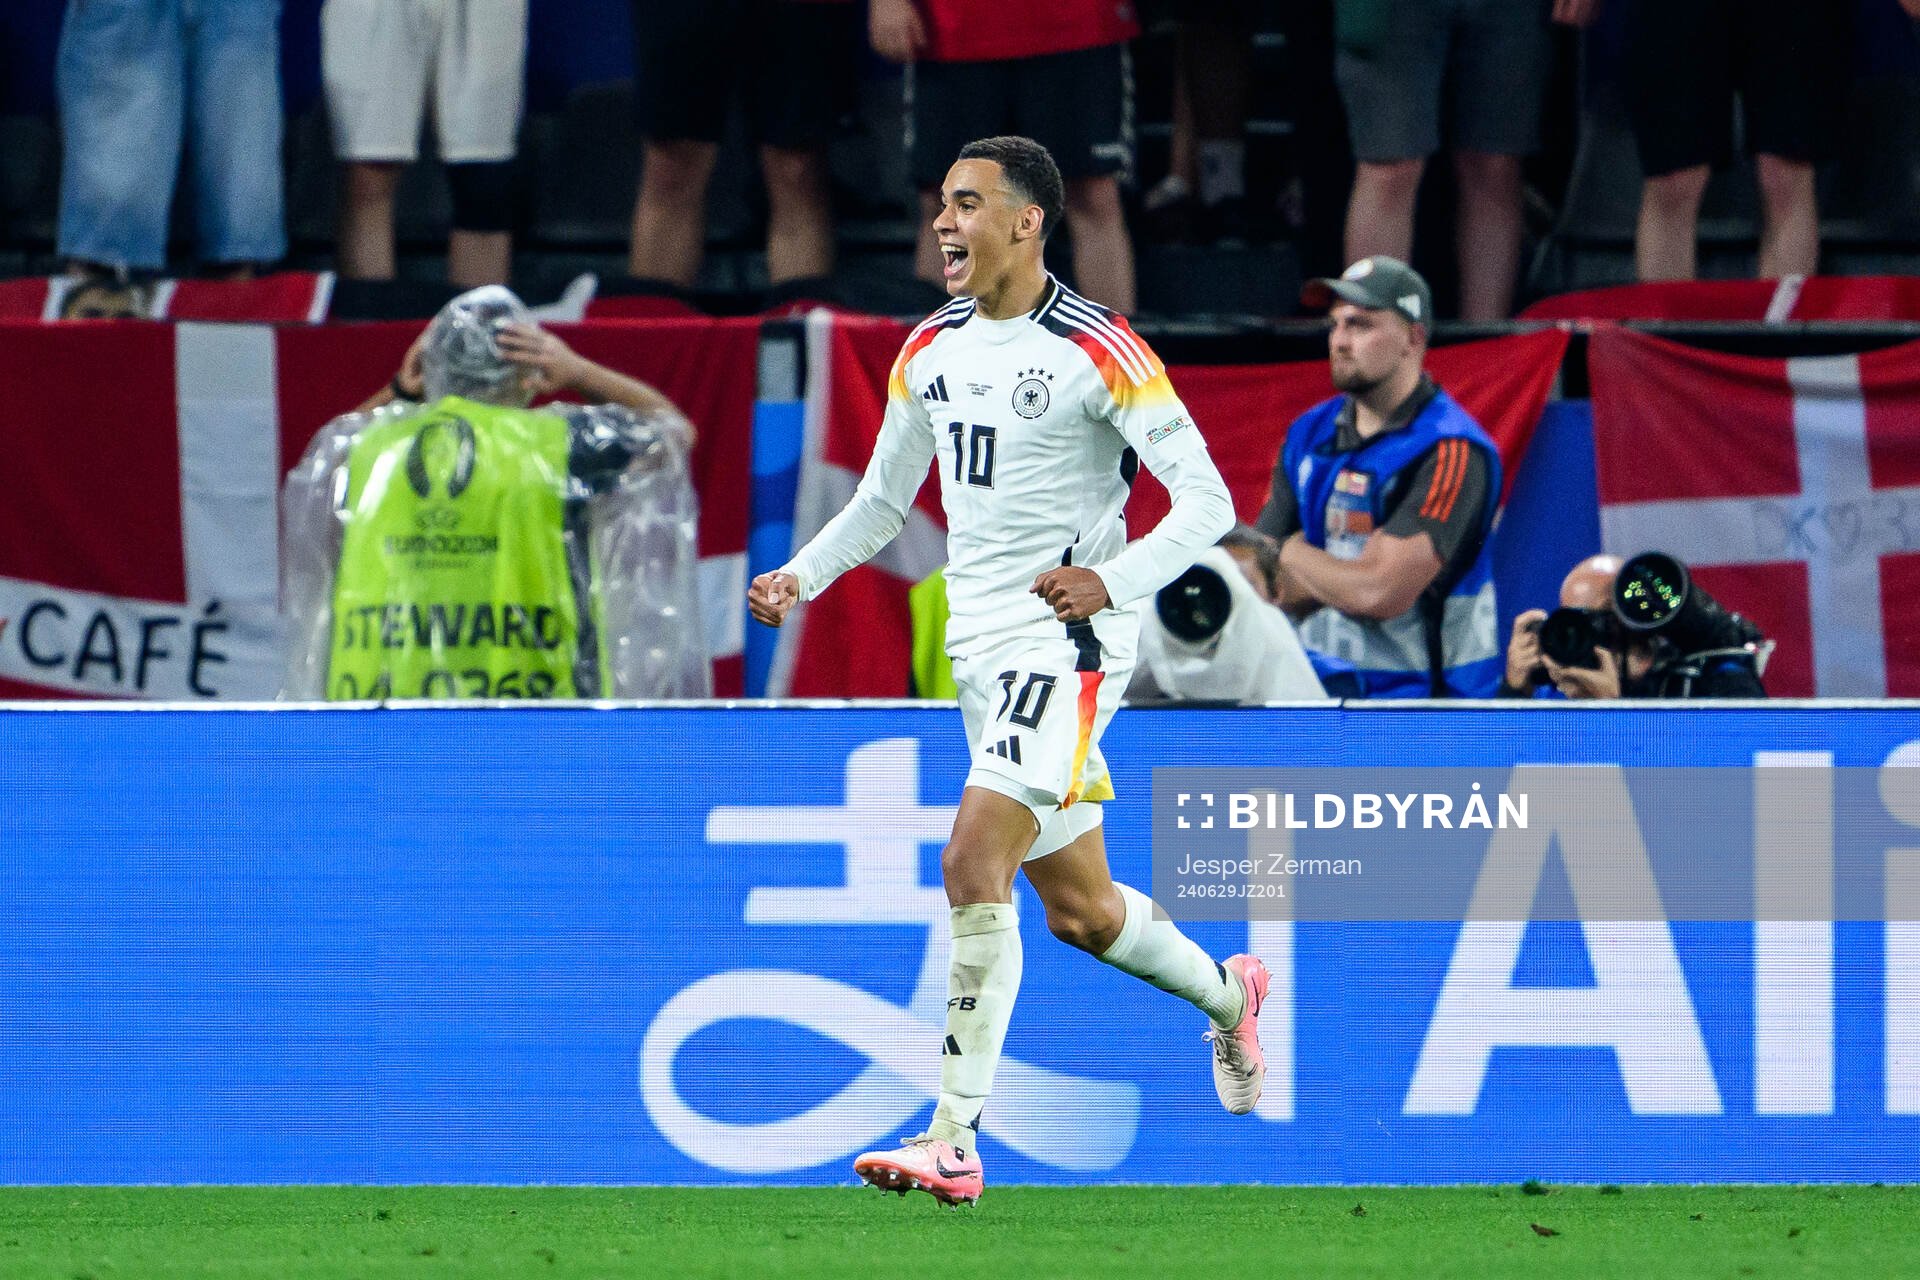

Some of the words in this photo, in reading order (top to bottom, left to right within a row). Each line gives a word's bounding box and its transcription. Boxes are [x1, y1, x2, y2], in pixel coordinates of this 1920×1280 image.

[949, 421, 997, 490] 10
[19, 599, 229, 697] CAFÉ
[996, 670, 1058, 733] 10
[947, 996, 977, 1013] FB
